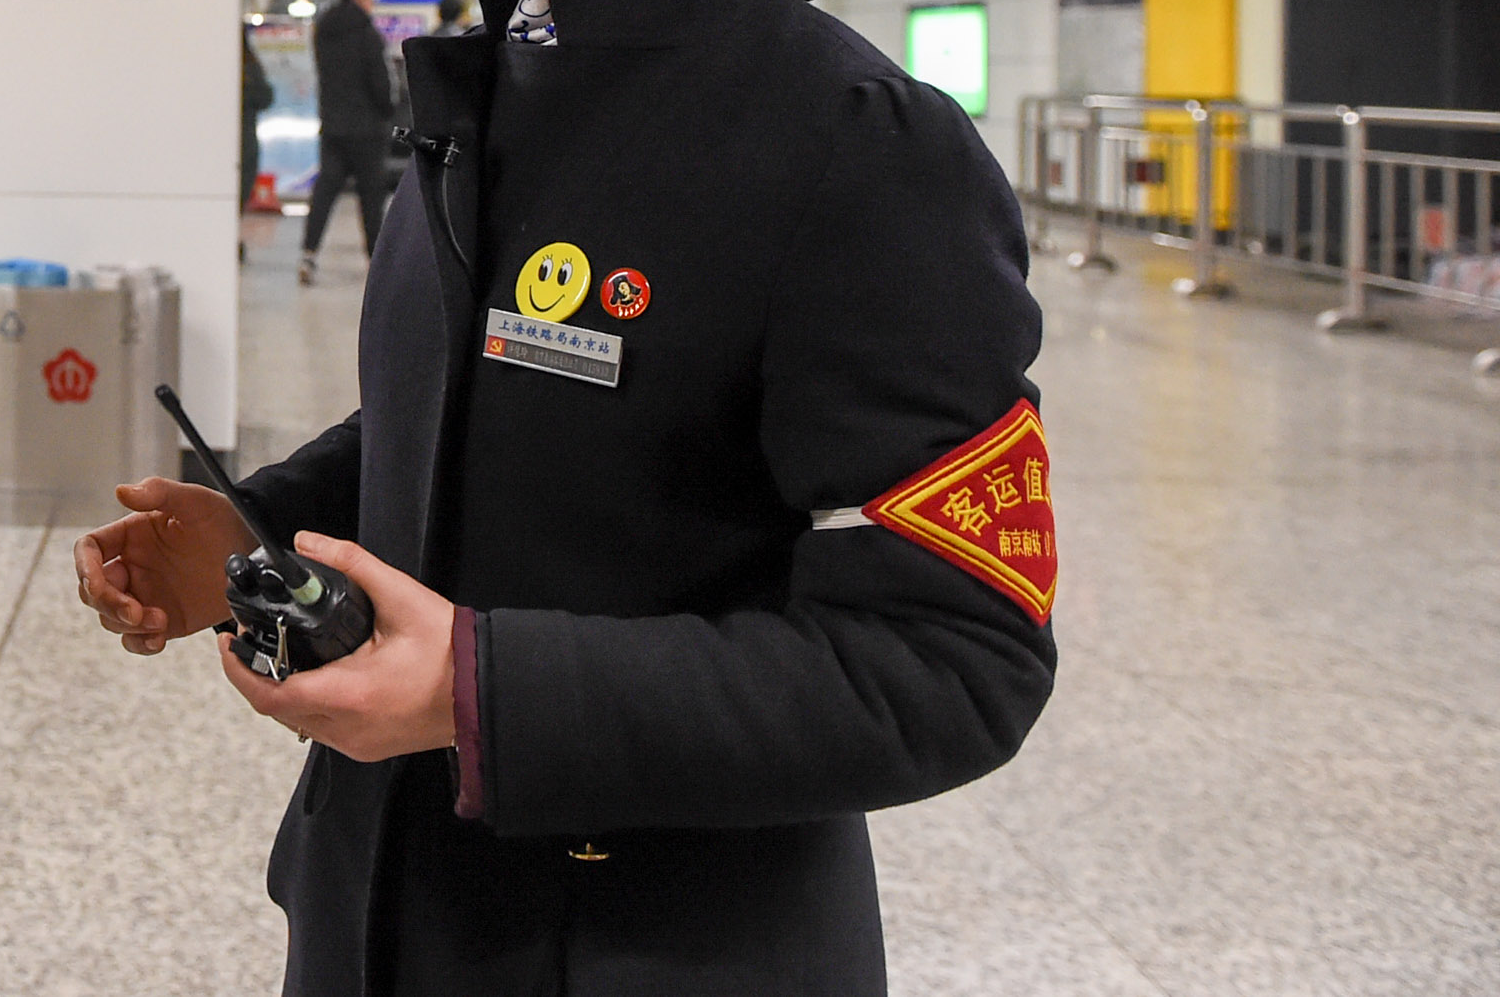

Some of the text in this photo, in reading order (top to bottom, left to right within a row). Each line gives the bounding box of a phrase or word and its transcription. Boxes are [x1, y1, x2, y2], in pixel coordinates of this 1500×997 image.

[499, 319, 610, 354] 上海铁路局南京站
[940, 456, 1052, 537] 客运值
